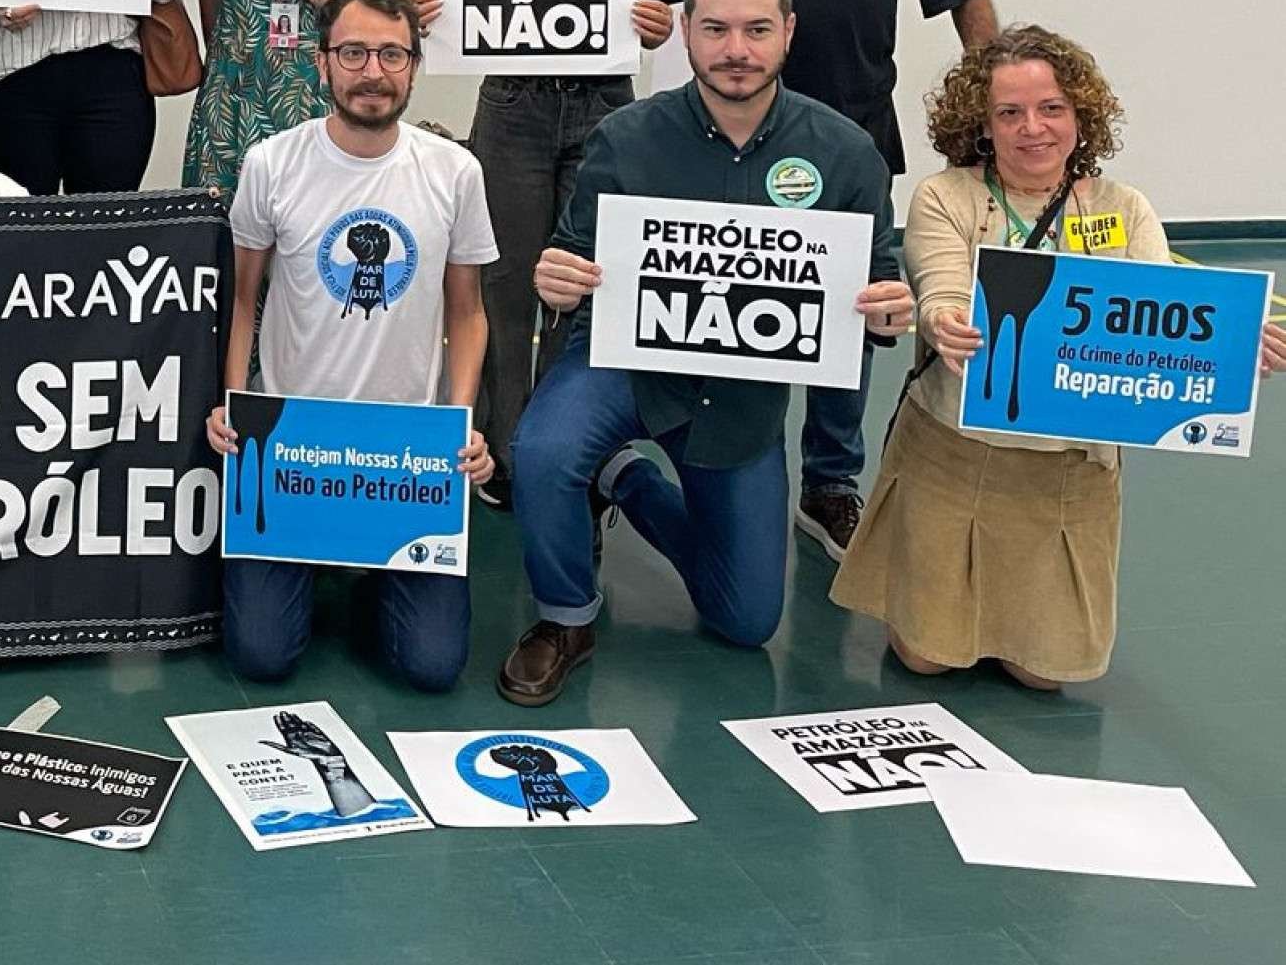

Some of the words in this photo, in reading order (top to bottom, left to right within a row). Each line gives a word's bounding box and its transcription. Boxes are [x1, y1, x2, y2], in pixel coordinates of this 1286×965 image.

[643, 219, 803, 252] PETRÓLEO
[806, 242, 828, 255] NA
[356, 265, 383, 274] MAR
[640, 248, 822, 285] AMAZÔNIA
[353, 289, 381, 299] LUTA
[360, 276, 376, 287] DE
[639, 282, 821, 355] NÃO!
[1062, 285, 1094, 337] 5
[1105, 296, 1217, 342] anos
[1058, 342, 1076, 361] do
[1079, 343, 1122, 366] Crime
[1126, 347, 1144, 368] do
[1148, 350, 1218, 374] Petróleo:
[1054, 364, 1175, 405] Reparação
[1179, 375, 1215, 405] Já!
[16, 355, 182, 453] SEM
[274, 442, 342, 467] Protejam
[345, 448, 398, 469] Nossas
[402, 446, 453, 474] Águas,
[274, 468, 315, 495] Não
[321, 478, 344, 498] ao
[352, 474, 450, 505] Petróleo!
[771, 717, 906, 741] PETRÓLEO
[791, 729, 945, 755] AMAZÔNIA
[12, 753, 21, 762] e
[25, 752, 86, 774] Plástico:
[240, 758, 282, 769] QUEM
[1, 764, 30, 779] das
[31, 769, 89, 788] Nossas
[91, 776, 149, 799] Águas!
[521, 773, 561, 783] MAR
[533, 784, 559, 794] DE
[529, 794, 574, 804] LUTA
